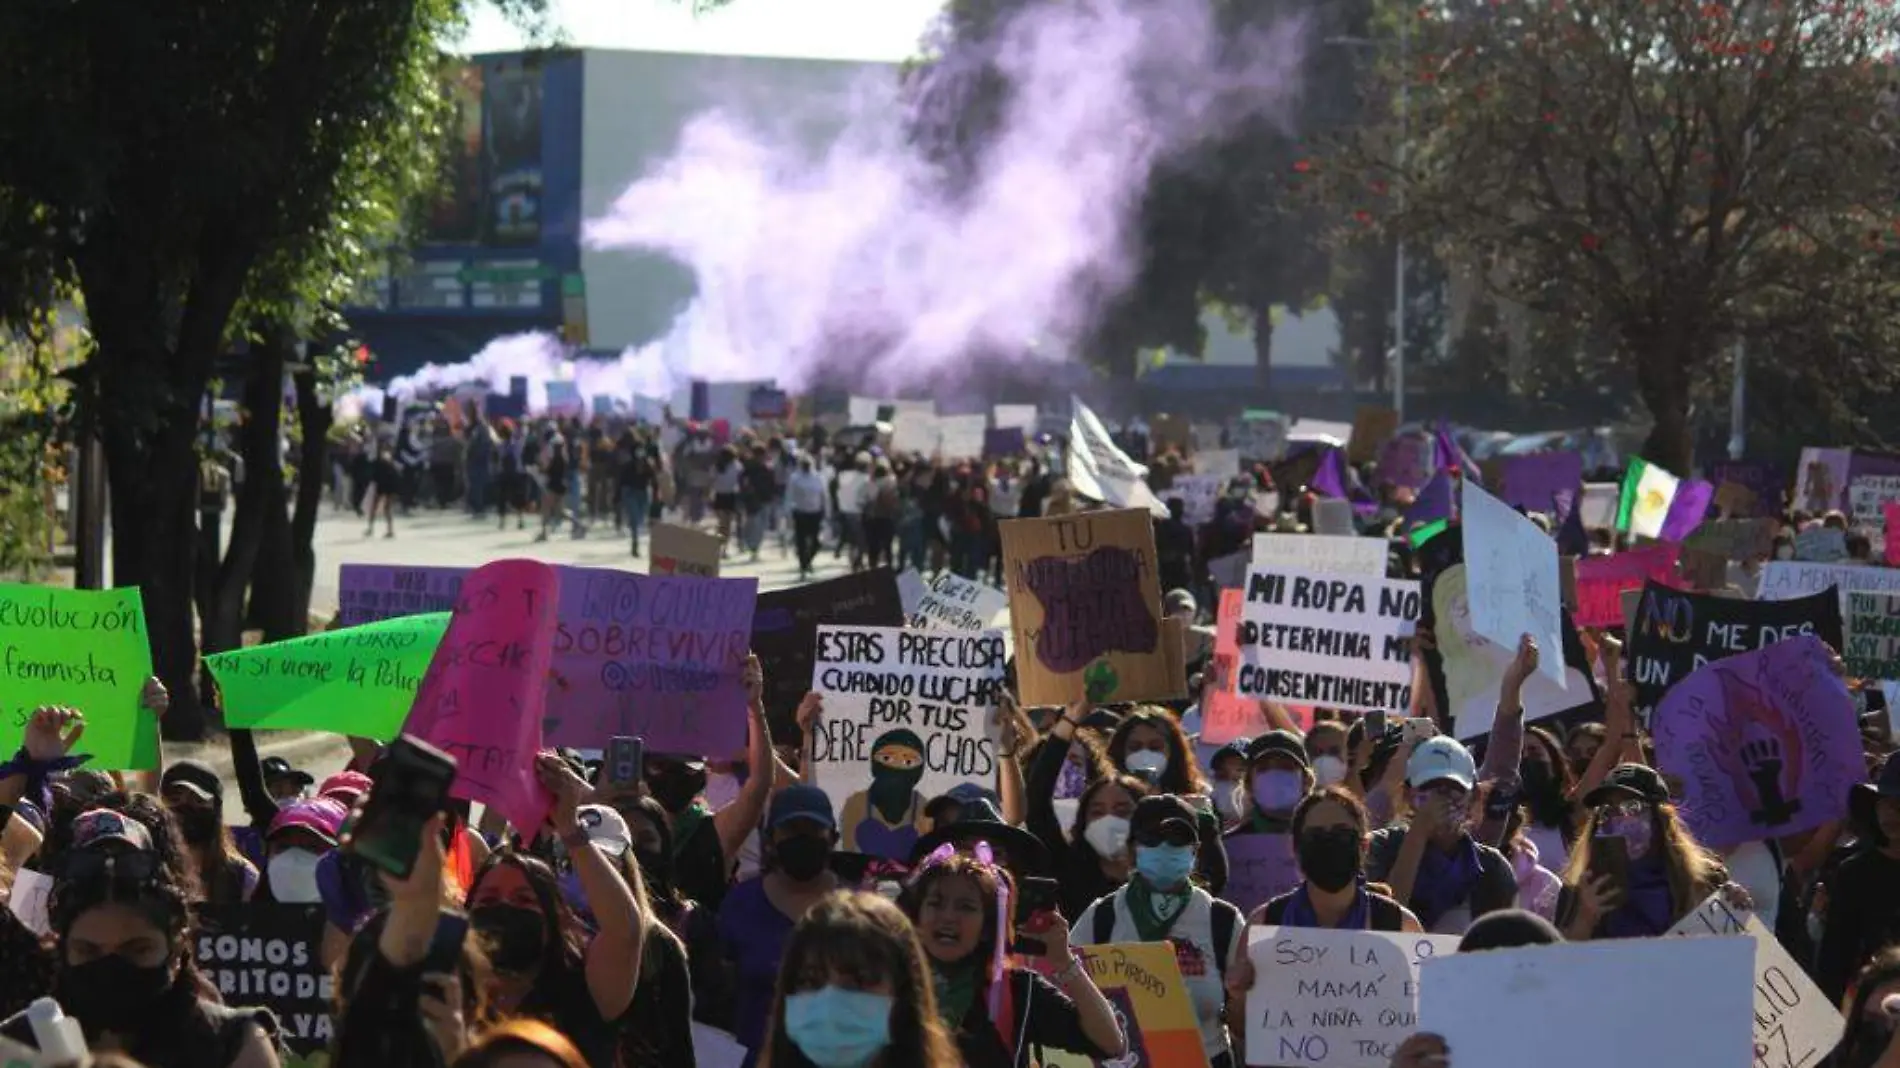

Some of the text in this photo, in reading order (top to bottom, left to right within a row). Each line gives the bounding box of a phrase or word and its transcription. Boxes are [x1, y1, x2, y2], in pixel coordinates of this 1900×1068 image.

[1049, 517, 1094, 551] TU
[1247, 572, 1286, 604] MI
[1291, 575, 1366, 614] ROPA
[1377, 586, 1420, 621] NO
[1639, 589, 1696, 643] NO
[1706, 620, 1748, 650] ME
[553, 621, 746, 664] SOBREVIVIR
[816, 630, 1007, 670] ESTAS PRECIOSA
[1240, 619, 1372, 661] DETERMINA
[5, 644, 117, 687] feminista
[346, 656, 367, 689] la
[821, 667, 915, 696] CUANDO
[1634, 655, 1671, 686] UN
[1238, 664, 1412, 710] CONSENTIMIENTO
[868, 697, 970, 732] POR TUS
[811, 718, 993, 776] DERE CHOS
[198, 934, 309, 967] SOMOS
[1275, 939, 1379, 968] SOY LA
[1110, 948, 1167, 999] PIROPO
[1297, 973, 1387, 999] MAMÁ
[1261, 1008, 1295, 1030] LA
[1311, 1005, 1363, 1028] NIÑA
[1278, 1034, 1402, 1062] NO TOC
